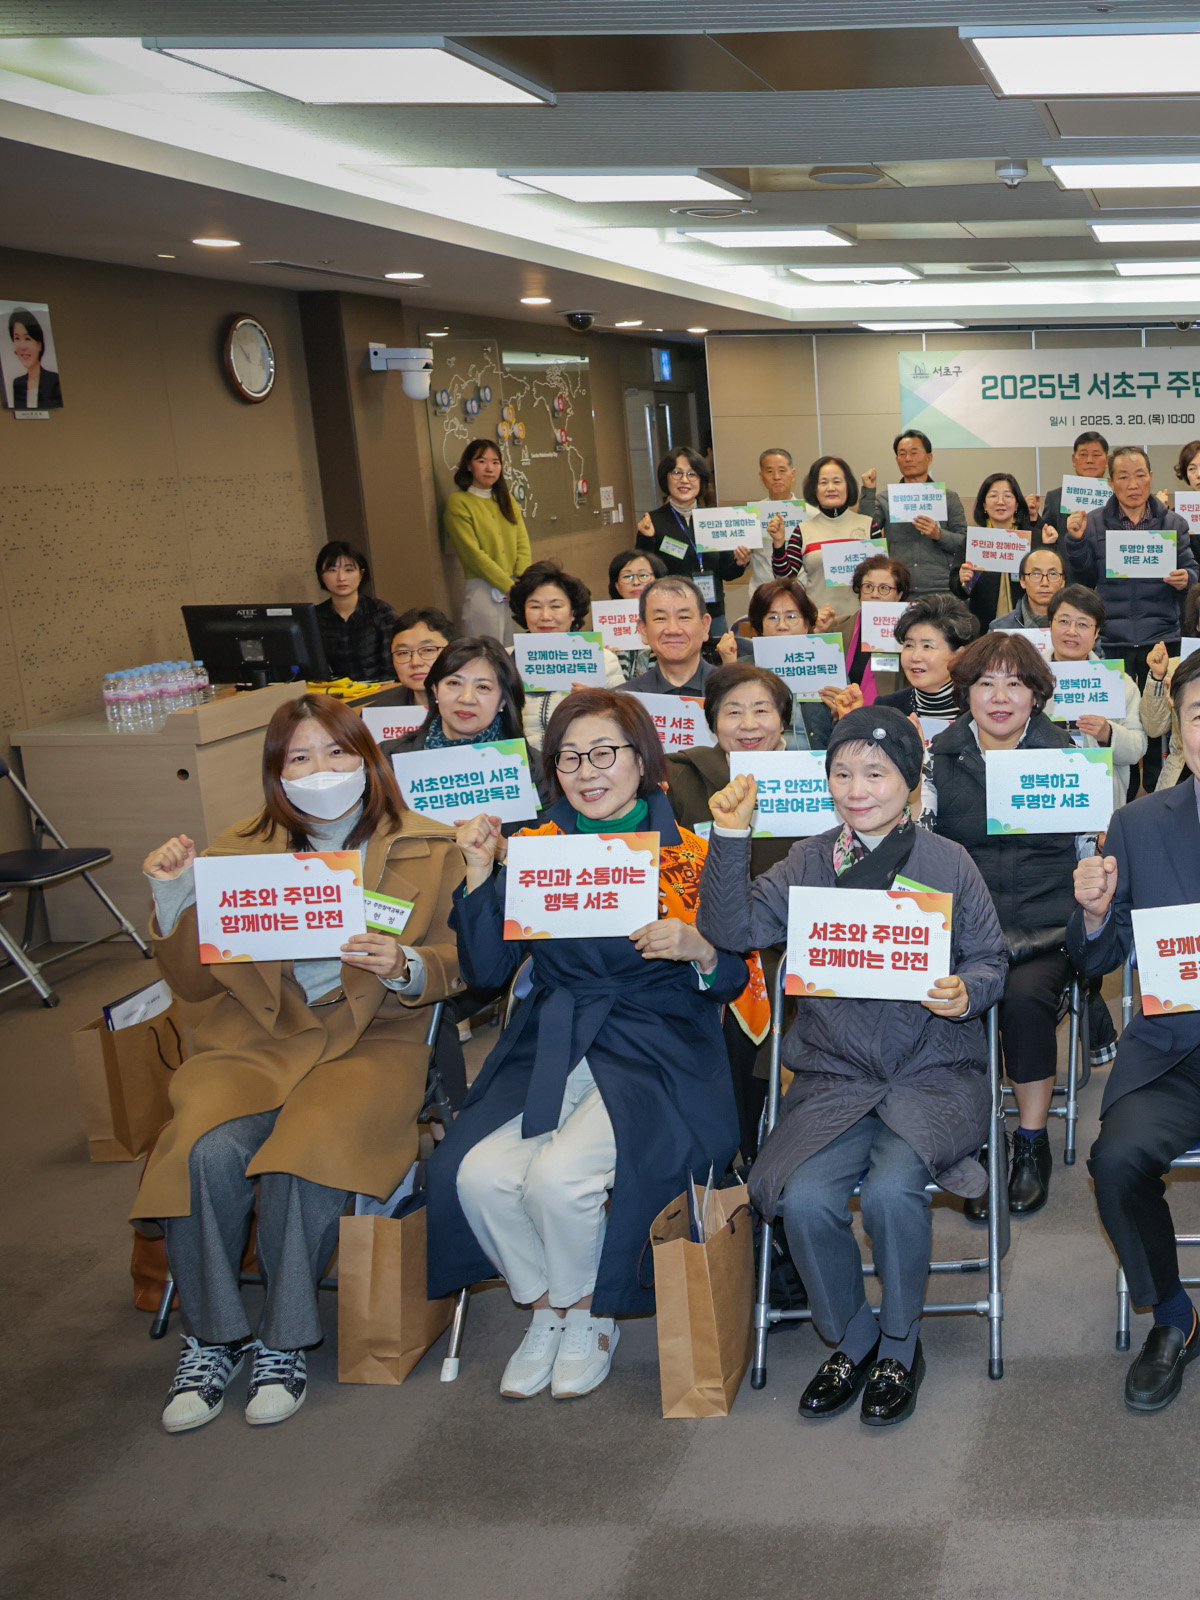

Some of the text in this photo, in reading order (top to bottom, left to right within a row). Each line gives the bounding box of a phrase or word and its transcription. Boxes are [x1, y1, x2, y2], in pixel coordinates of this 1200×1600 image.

[932, 365, 963, 378] 서초구
[981, 373, 1081, 400] 2025년
[1087, 371, 1162, 399] 서초구
[1049, 413, 1195, 427] 일시 2025. 3. 20. (목) 10:00
[892, 493, 943, 503] 청렴하고 깨끗한
[1066, 486, 1093, 497] 청렴하고
[903, 502, 933, 511] 푸른 서초
[1075, 496, 1104, 506] 푸른 서초
[698, 518, 756, 529] 주민과 함께하는
[711, 529, 746, 539] 행복 서초
[970, 540, 1027, 552] 주민과 함께하는
[1119, 544, 1164, 554] 투명한 행정
[981, 550, 1015, 561] 행복 서초
[1123, 555, 1159, 565] 맑은 서초
[598, 615, 627, 625] 주민과
[613, 626, 632, 637] 행복
[527, 648, 593, 661] 함께하는 안전
[783, 651, 816, 664] 서초구
[524, 662, 598, 675] 주민참여감독관
[1059, 677, 1102, 690] 행복하고
[1053, 691, 1109, 705] 투명한 서초
[669, 717, 695, 730] 서초
[669, 733, 695, 746] 서초
[409, 766, 519, 795] 서초안전의 시작
[1019, 773, 1081, 790] 행복하고
[413, 784, 521, 812] 주민참여감독관
[1010, 793, 1090, 810] 투명한 서초
[518, 866, 647, 888] 주민과 소통하는
[219, 884, 343, 909] 서초와 주민의
[543, 891, 619, 912] 행복 서초
[219, 909, 345, 935] 함께하는 안전
[808, 921, 931, 946] 서초와 주민의
[808, 946, 929, 972] 함께하는 안전
